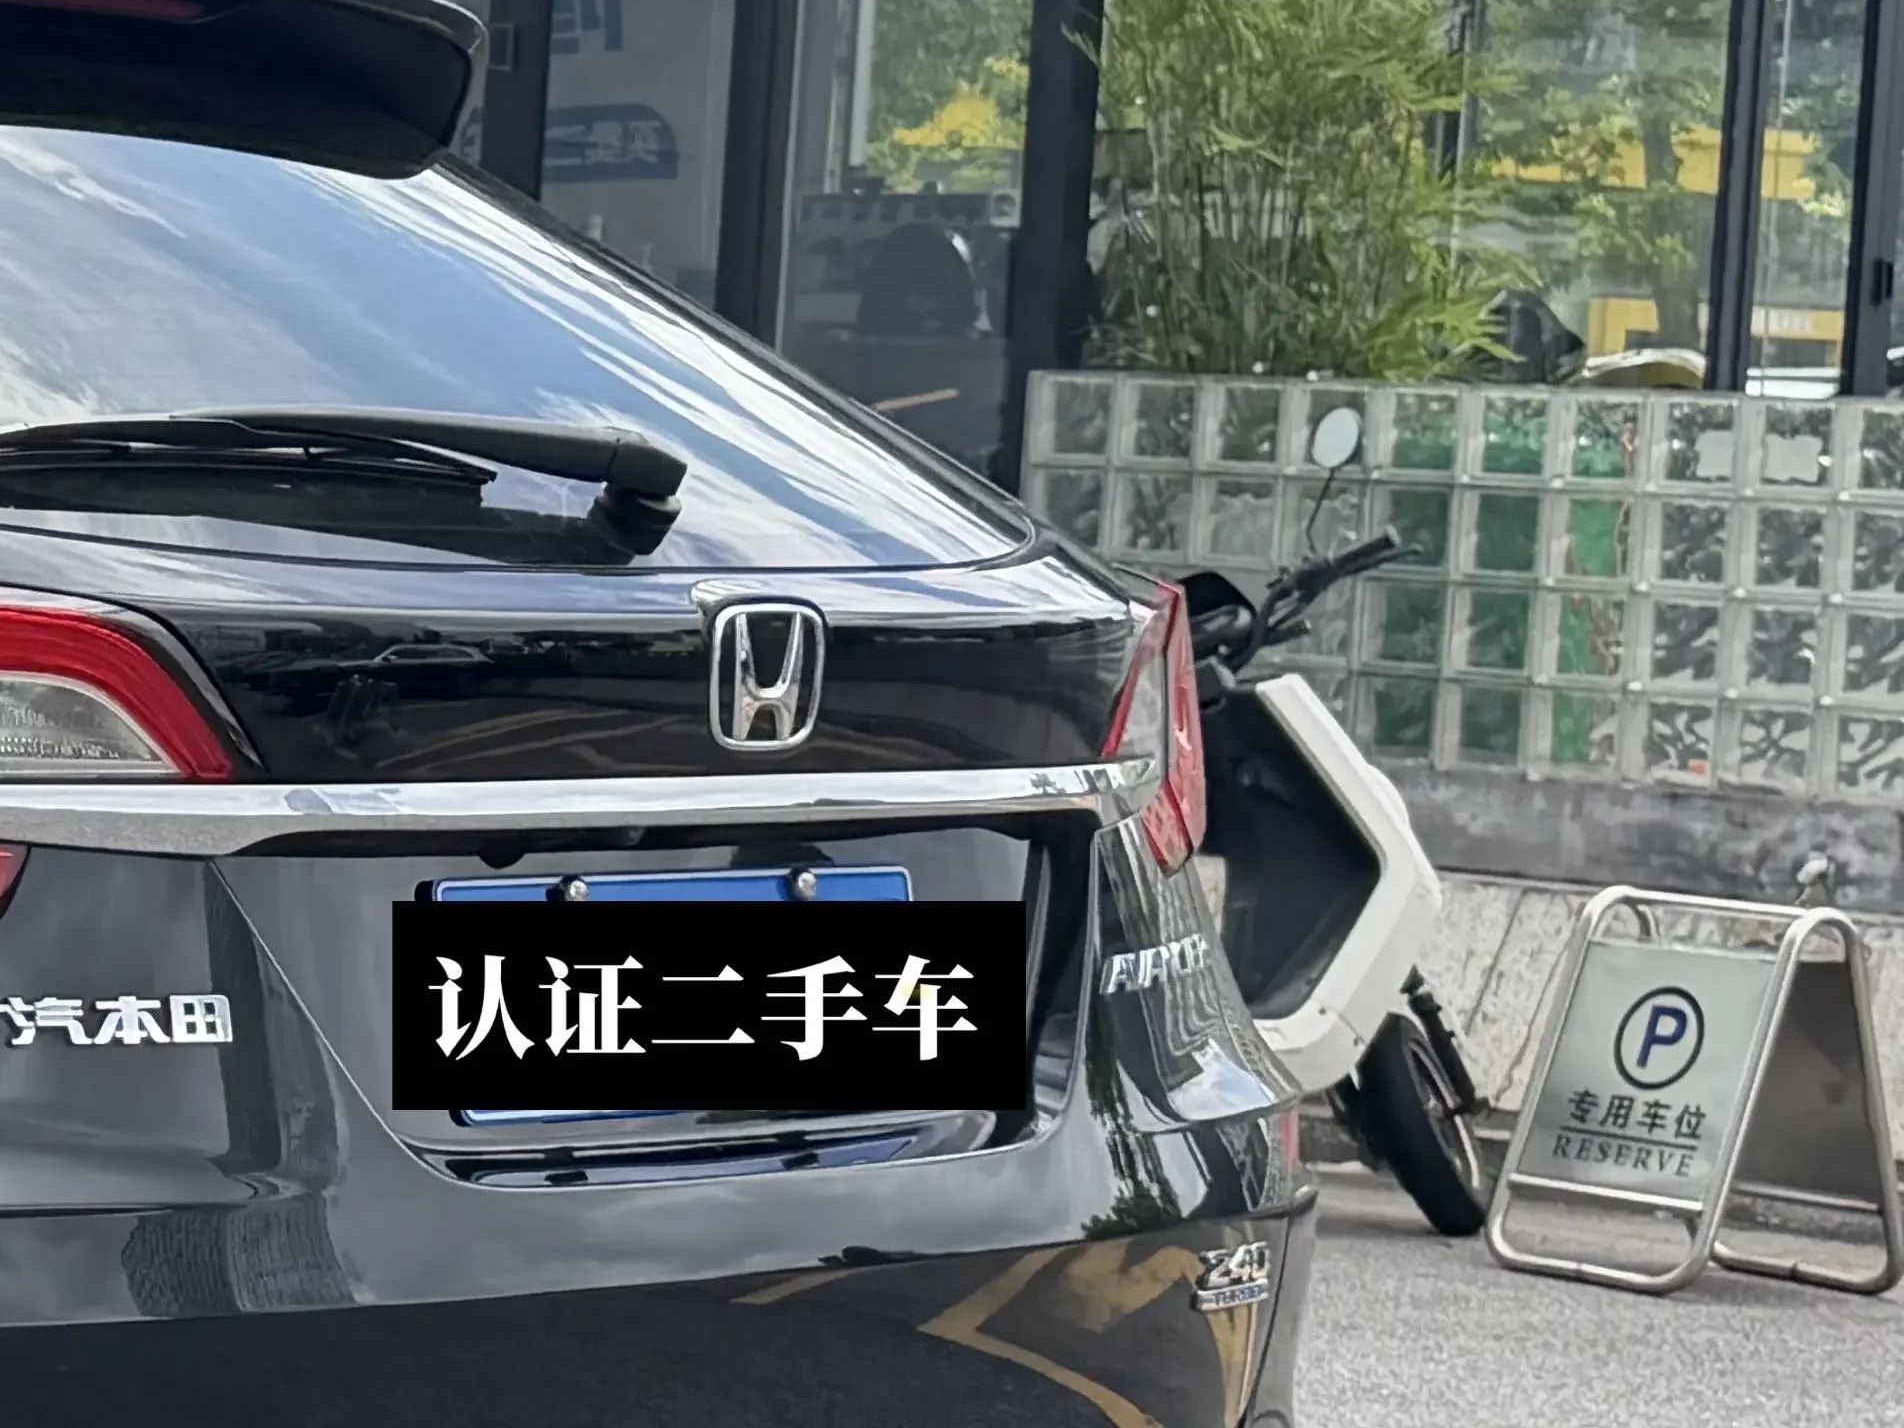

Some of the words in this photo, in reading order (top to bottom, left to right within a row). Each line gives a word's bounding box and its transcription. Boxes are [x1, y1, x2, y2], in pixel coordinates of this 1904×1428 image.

[1636, 1004, 1689, 1069] P
[1568, 1087, 1706, 1139] 专用车位
[1552, 1134, 1694, 1177] RESERVE
[1199, 1241, 1270, 1288] 240
